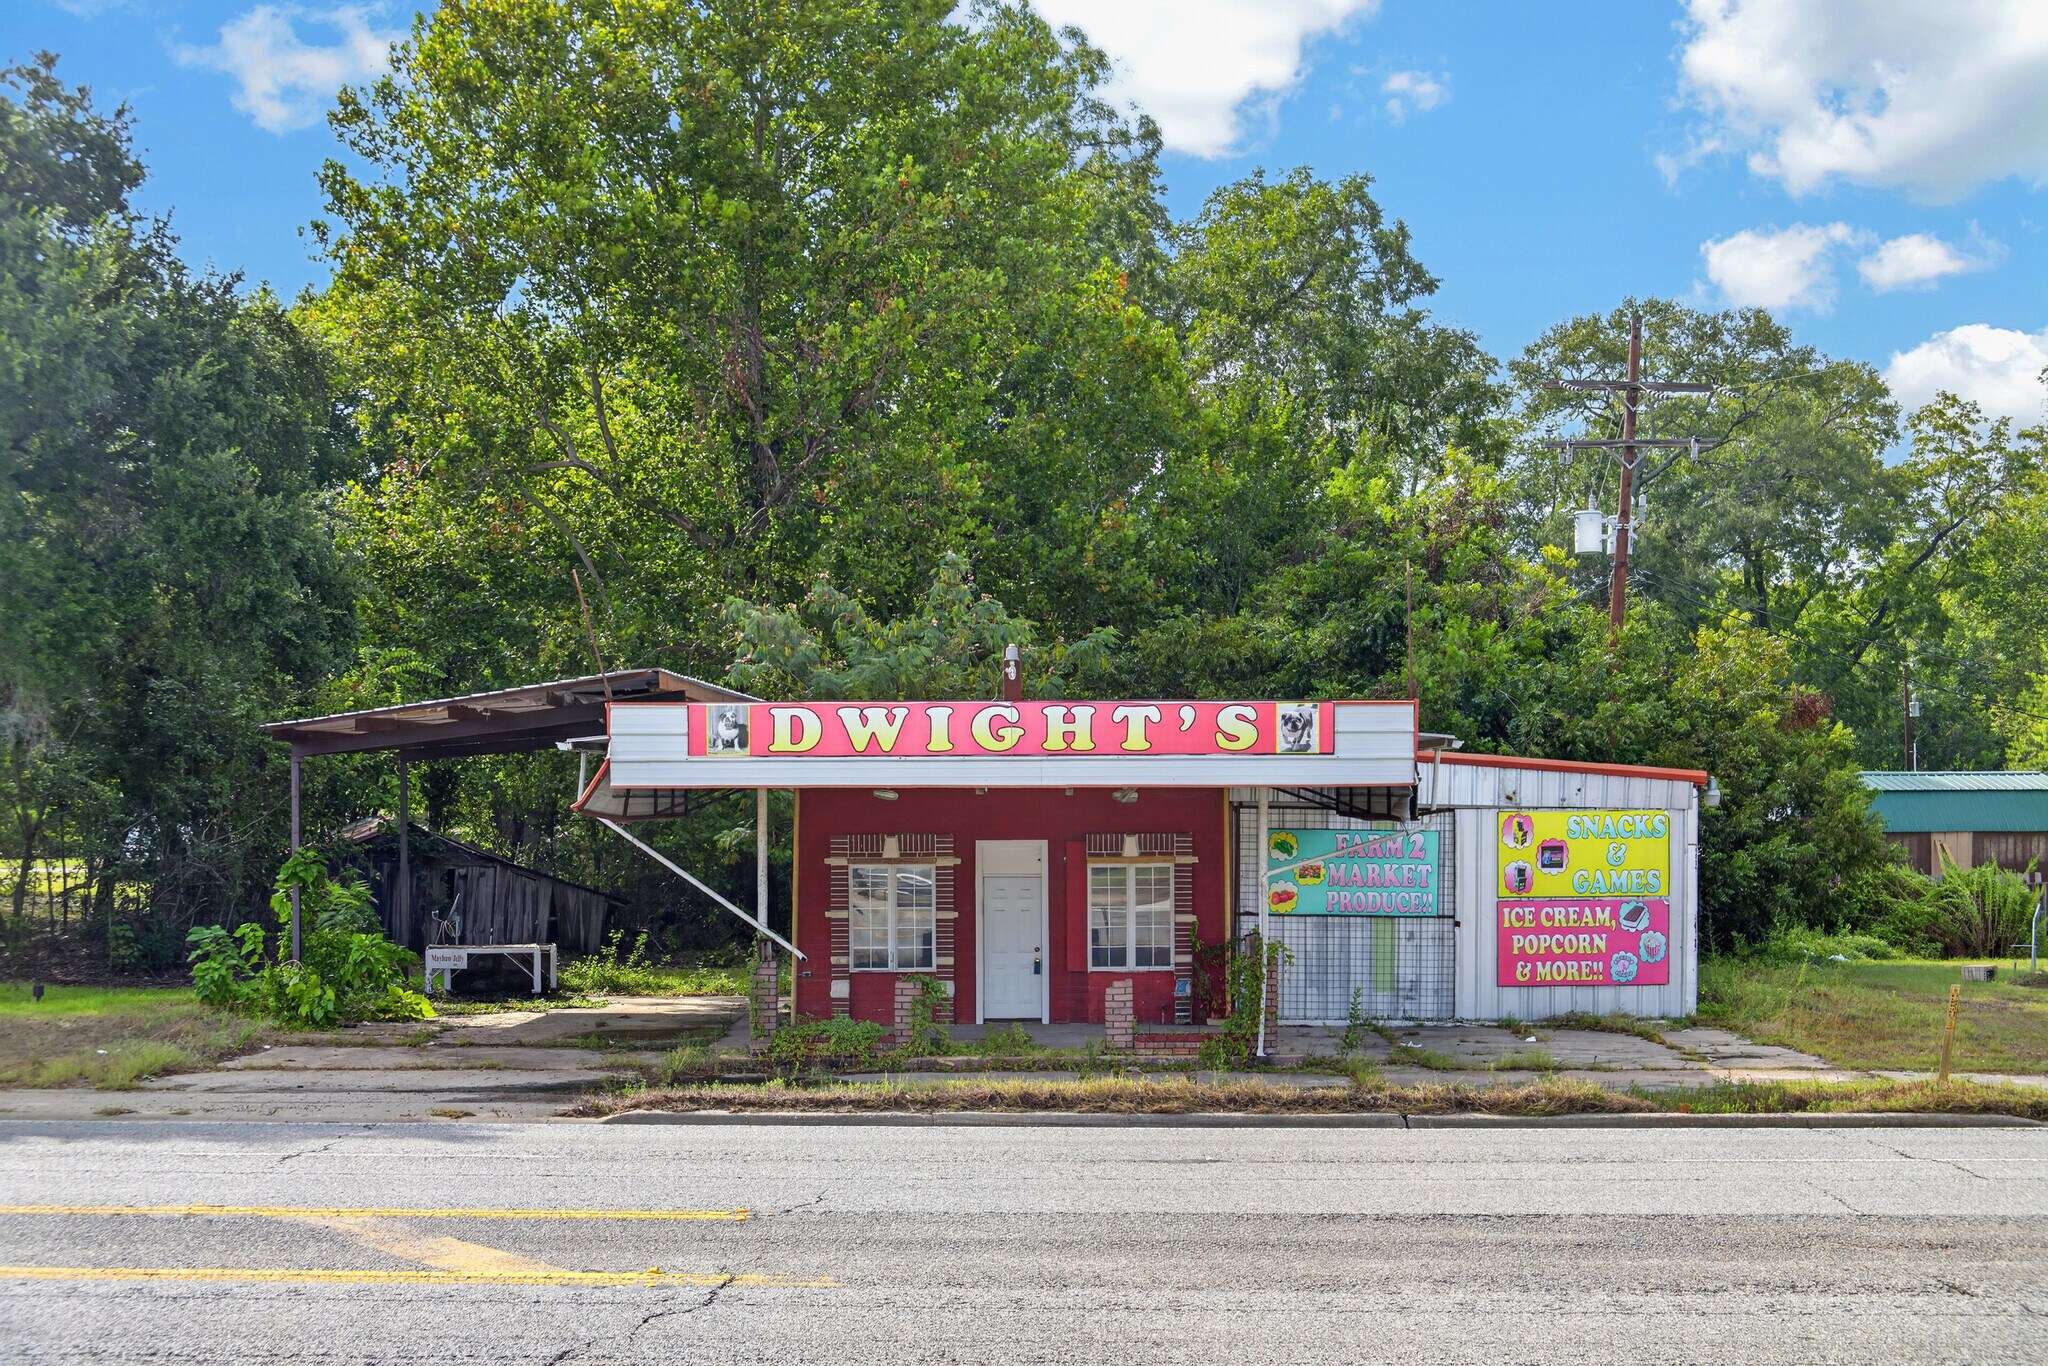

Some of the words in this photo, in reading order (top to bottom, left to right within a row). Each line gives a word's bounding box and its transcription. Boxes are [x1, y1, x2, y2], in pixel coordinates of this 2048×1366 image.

[768, 705, 1260, 753] DWIGHT'S
[1566, 814, 1667, 839] SNACKS
[1335, 833, 1404, 859] FARM
[1408, 832, 1427, 860] 2
[1606, 842, 1627, 866] &
[1327, 863, 1432, 888] MARKET
[1572, 869, 1661, 894] GAMES
[1326, 891, 1433, 914] PRODUCE!!
[1502, 907, 1536, 928] ICE
[1540, 906, 1616, 932] CREAM,
[1511, 934, 1608, 955] POPCORN
[1515, 961, 1532, 982] &
[1535, 960, 1604, 982] MORE!!
